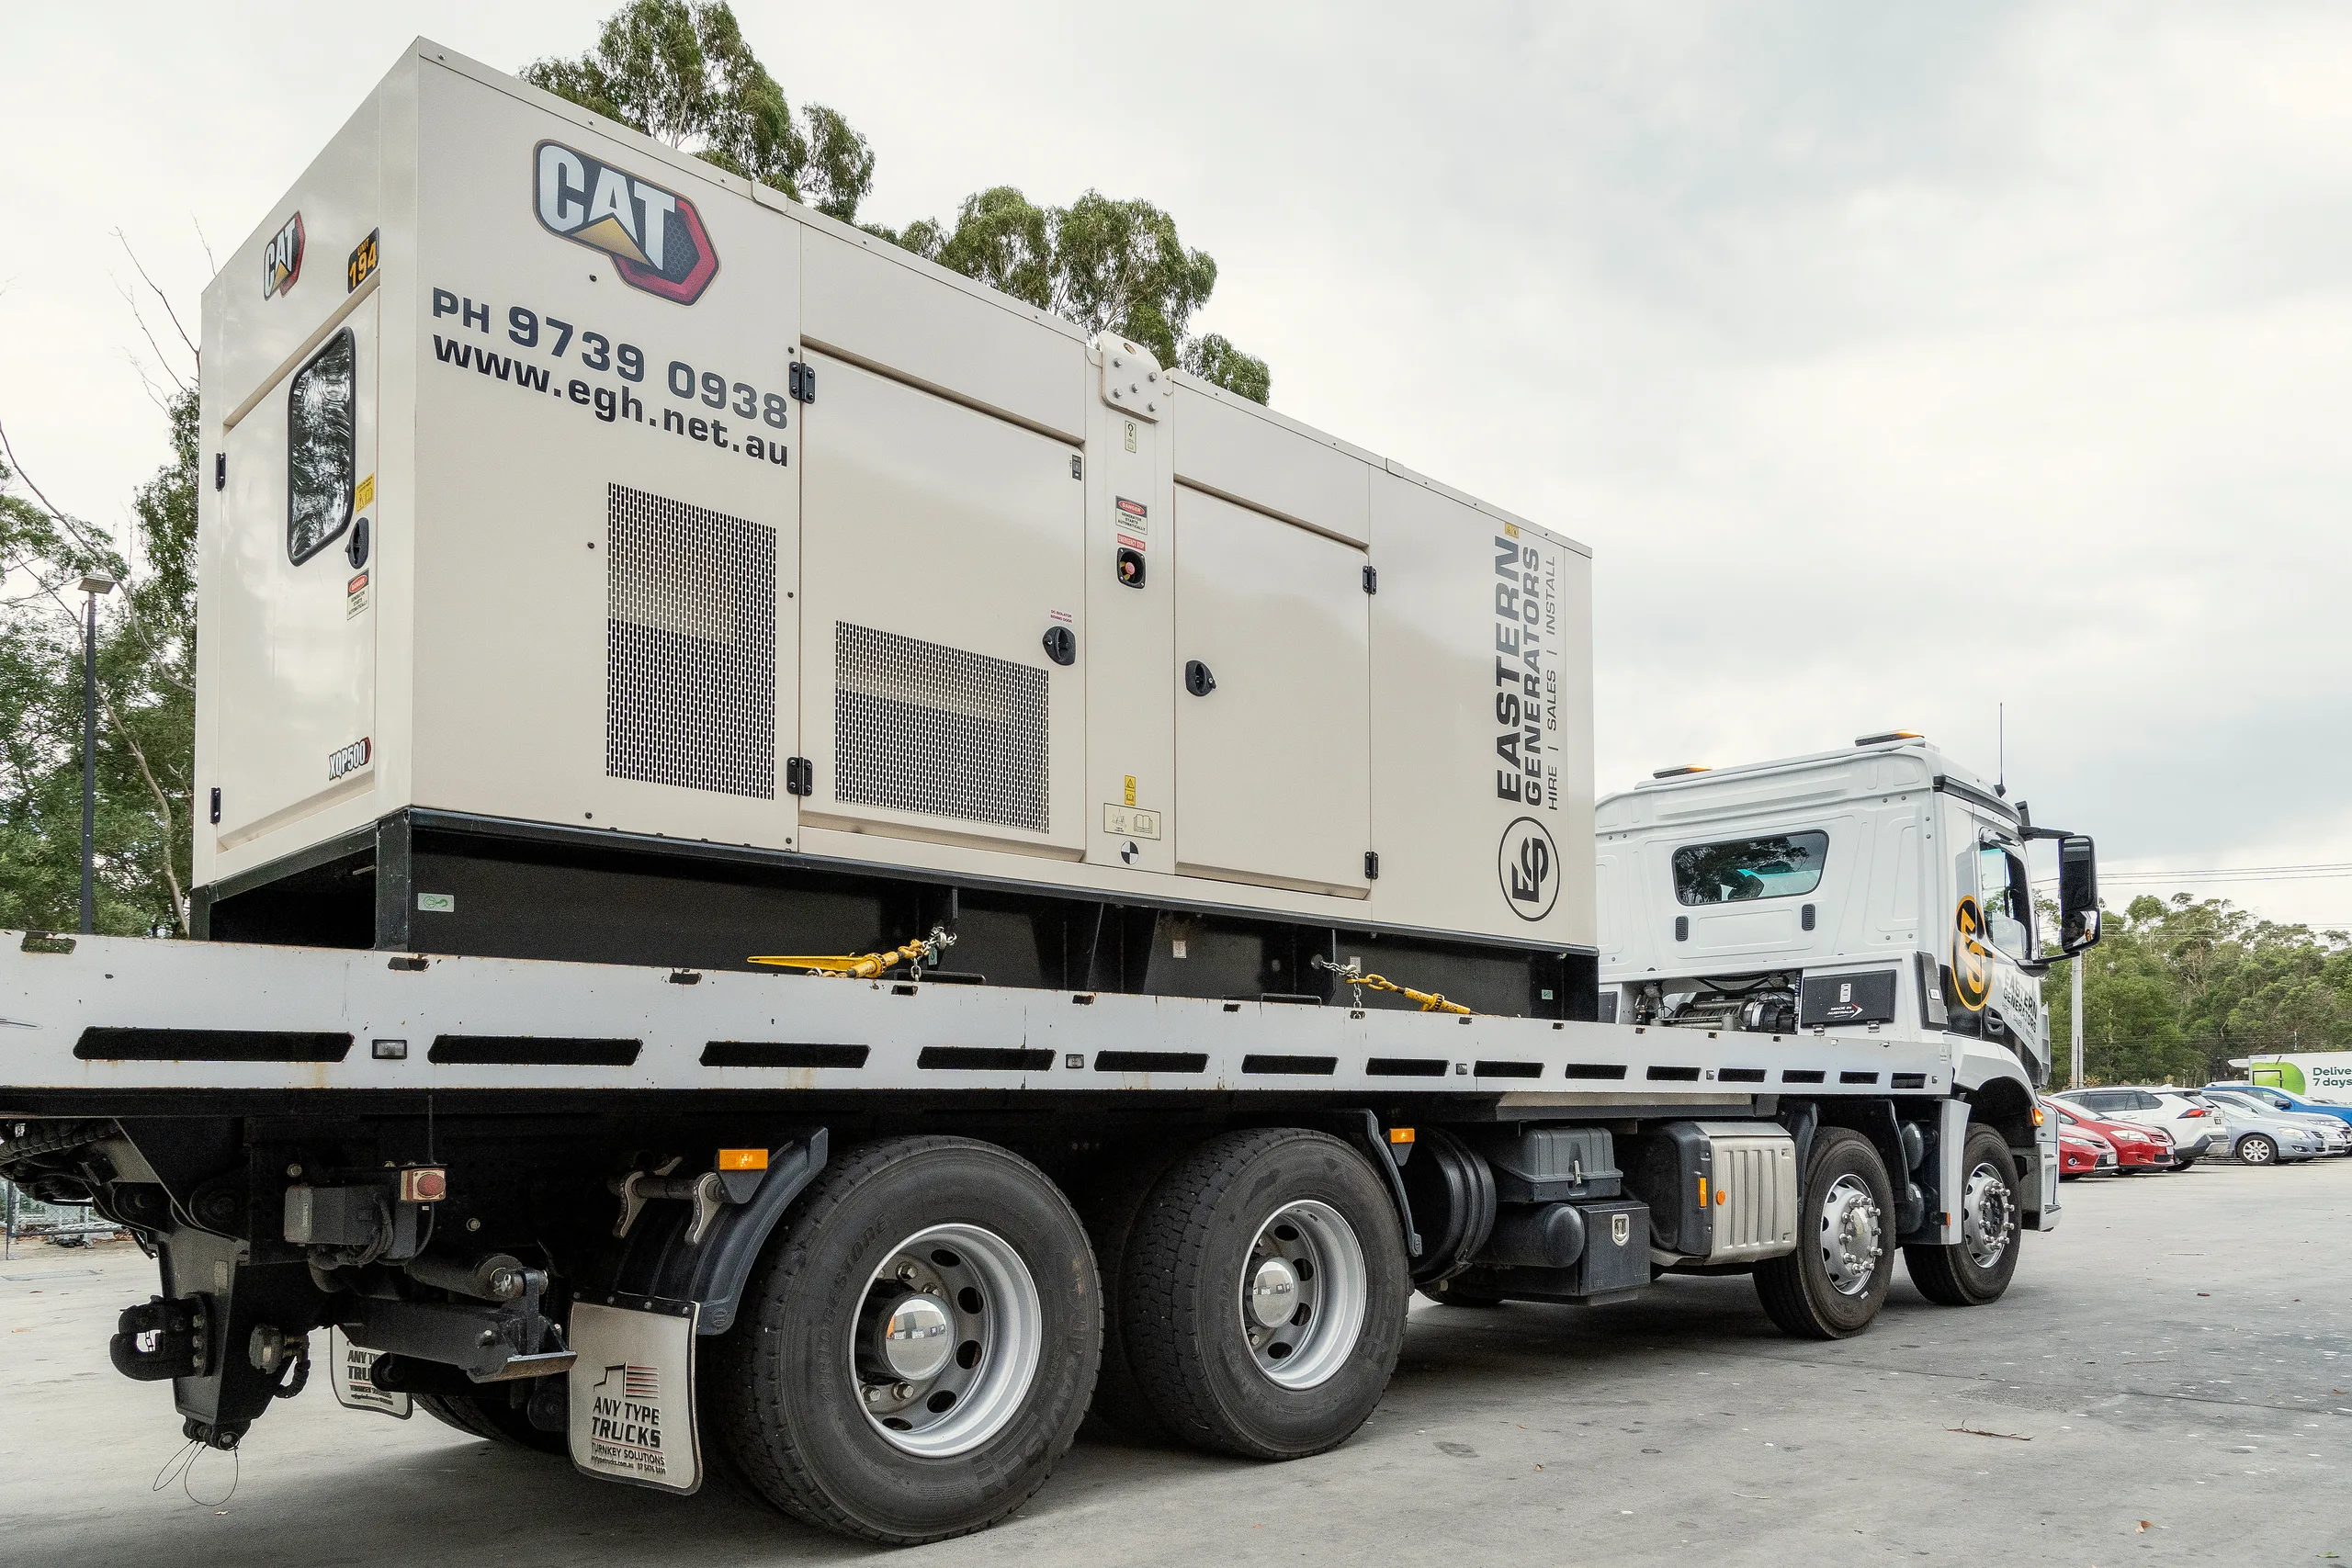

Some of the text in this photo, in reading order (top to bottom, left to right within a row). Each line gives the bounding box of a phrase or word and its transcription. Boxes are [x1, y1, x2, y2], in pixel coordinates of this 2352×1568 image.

[540, 145, 675, 270] CAT
[265, 217, 296, 298] CAT
[349, 241, 377, 288] 194
[433, 287, 787, 430] PH 9739 0938
[433, 334, 788, 467] www.egh.net.au
[1118, 519, 1146, 531] AUTOMATICALLY
[1122, 502, 1141, 513] DANGER
[1122, 512, 1142, 522] GENERATOR
[1125, 517, 1138, 525] STARTS
[1118, 535, 1145, 549] EMERGENCY STOP
[1545, 556, 1555, 636] INSTALL
[1495, 536, 1521, 803] EASTERN
[1522, 547, 1542, 807] GENERATORS
[1546, 669, 1557, 731] SALES
[330, 740, 366, 779] XQP500
[1547, 764, 1558, 810] HIRE
[347, 1350, 368, 1364] ANY
[593, 1396, 661, 1426] ANY TYPE
[592, 1416, 662, 1449] TRUCKS
[591, 1442, 665, 1466] TURNKEY SOLUTIONS
